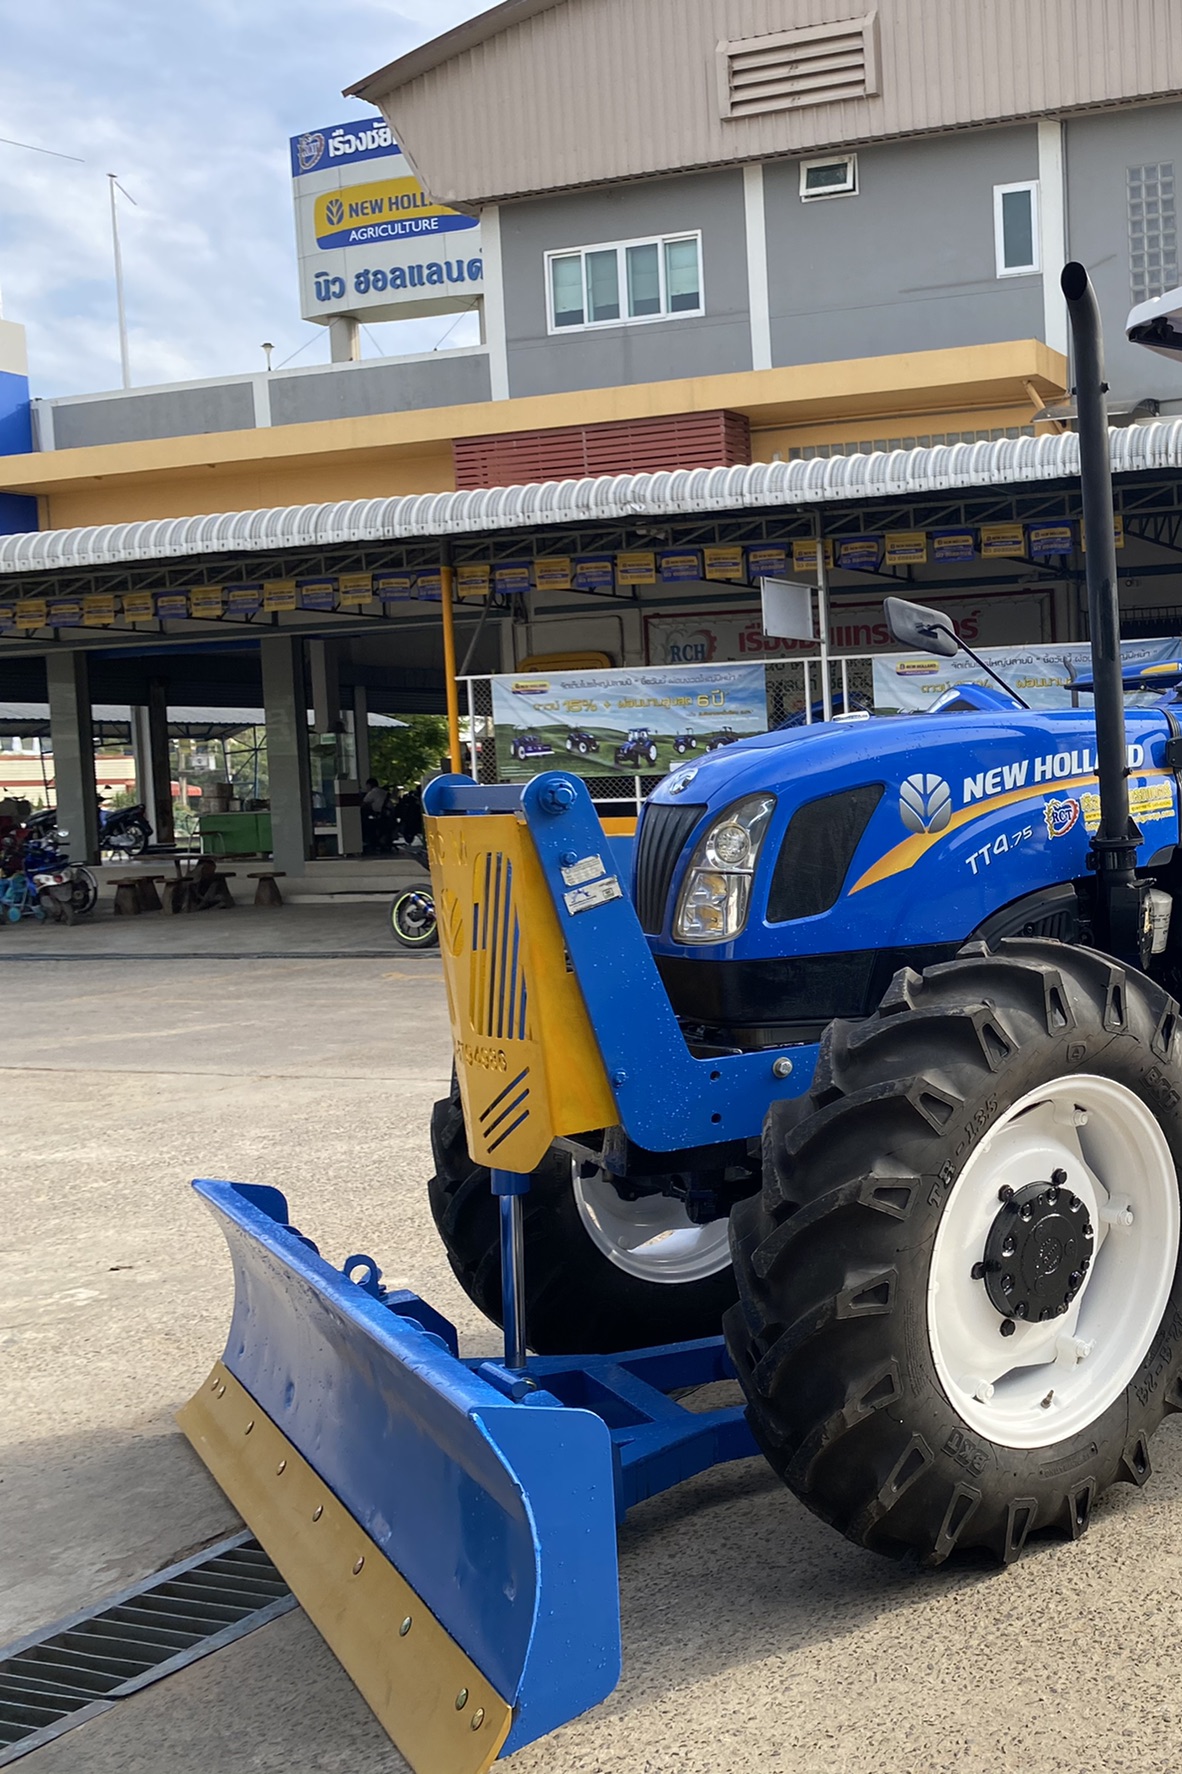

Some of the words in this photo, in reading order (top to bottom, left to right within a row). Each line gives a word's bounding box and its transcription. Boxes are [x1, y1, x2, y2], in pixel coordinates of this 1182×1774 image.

[328, 121, 399, 158] เรืองชัย
[348, 199, 384, 219] NEW
[388, 192, 432, 212] HOLL
[349, 217, 439, 242] AGRICULTURE
[314, 270, 346, 301] นิว
[670, 643, 705, 662] RCH
[963, 759, 1029, 803] NEW
[1034, 744, 1144, 782] HOLLD
[1051, 807, 1073, 828] RCT
